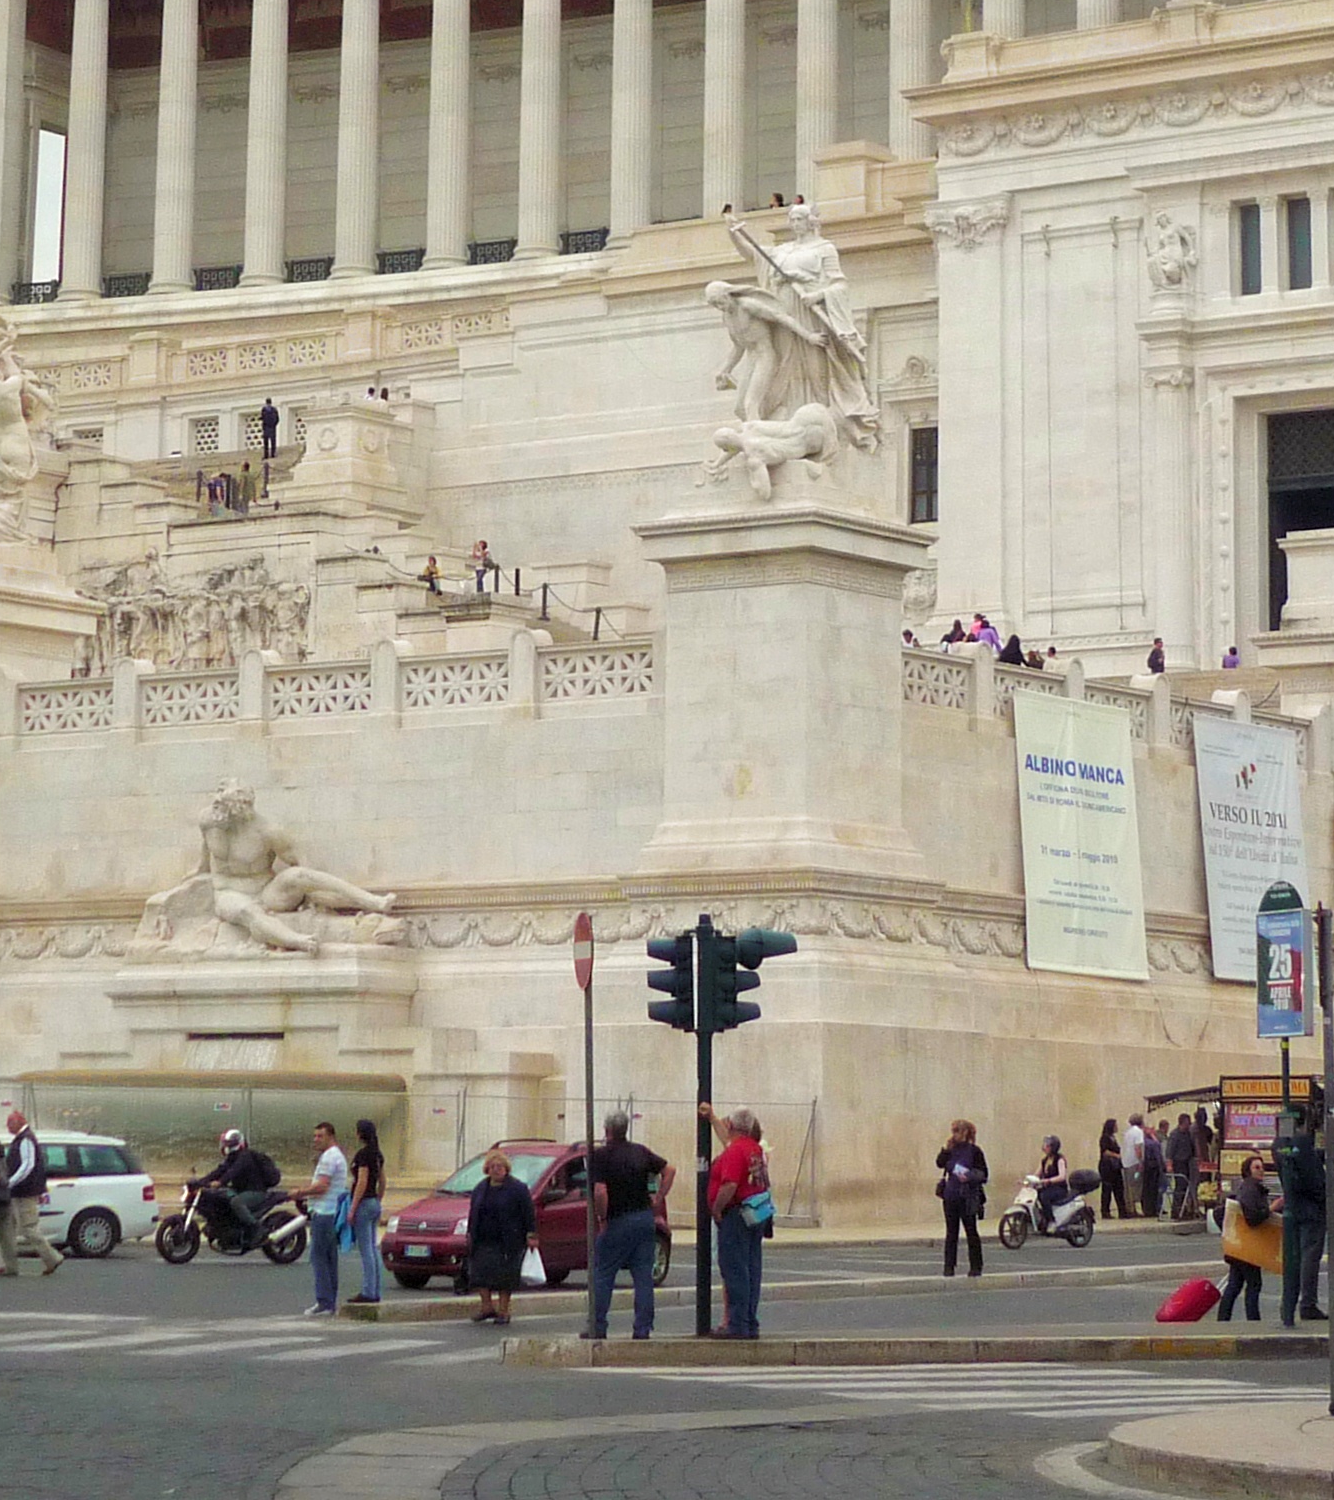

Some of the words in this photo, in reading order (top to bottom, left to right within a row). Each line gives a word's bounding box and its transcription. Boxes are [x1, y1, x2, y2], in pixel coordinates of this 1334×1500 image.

[1024, 753, 1076, 778] ALBINO
[1078, 762, 1125, 786] MANCA
[1209, 801, 1247, 825] VERSO
[1250, 808, 1263, 827] IL
[1264, 811, 1288, 830] 2011
[1268, 943, 1293, 980] 25
[1270, 986, 1292, 999] APRILE
